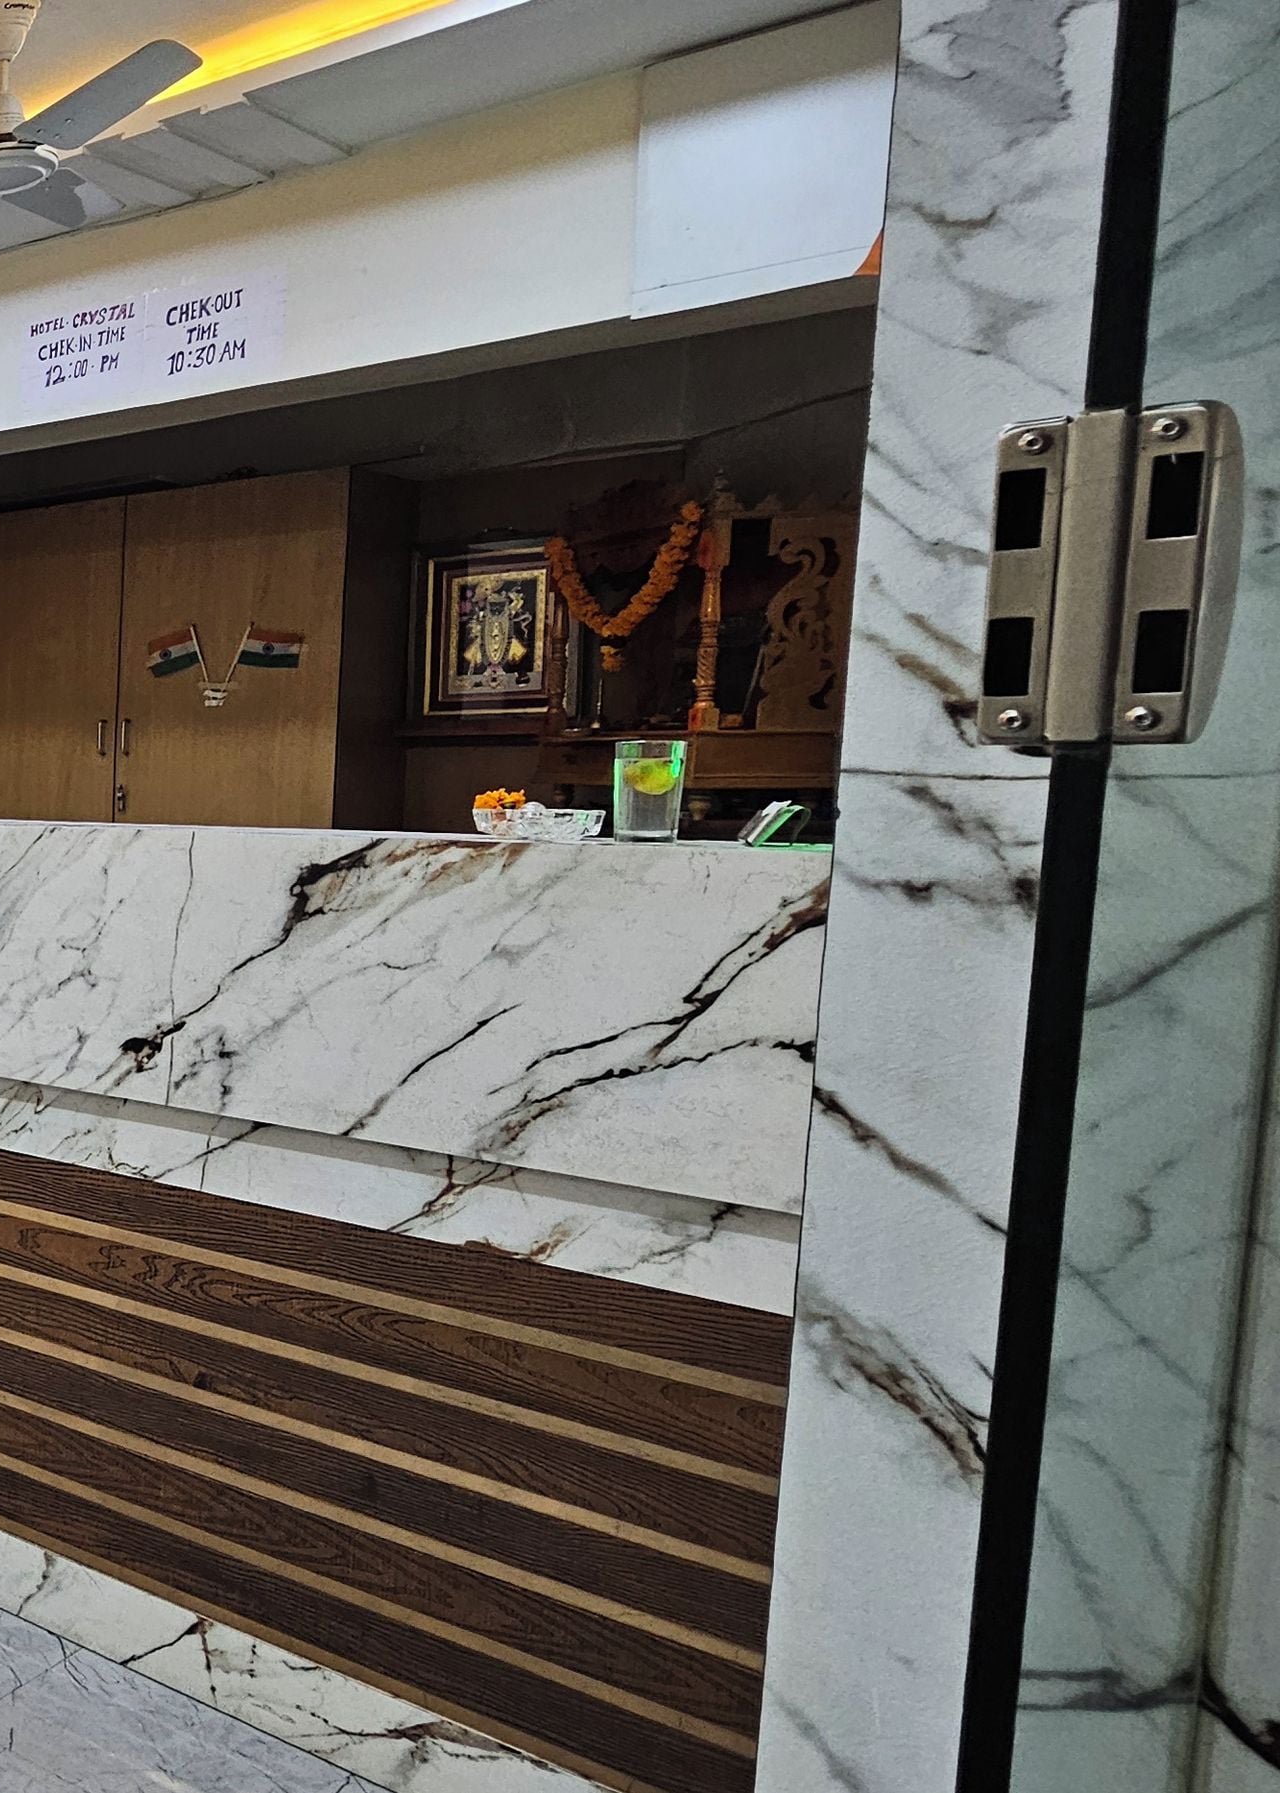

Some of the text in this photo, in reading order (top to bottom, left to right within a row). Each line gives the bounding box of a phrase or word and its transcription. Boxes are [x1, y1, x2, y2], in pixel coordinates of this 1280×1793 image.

[72, 302, 135, 329] CRYSTAL
[45, 351, 120, 388] 12:00 PM
[166, 338, 246, 376] 10:30 AM
